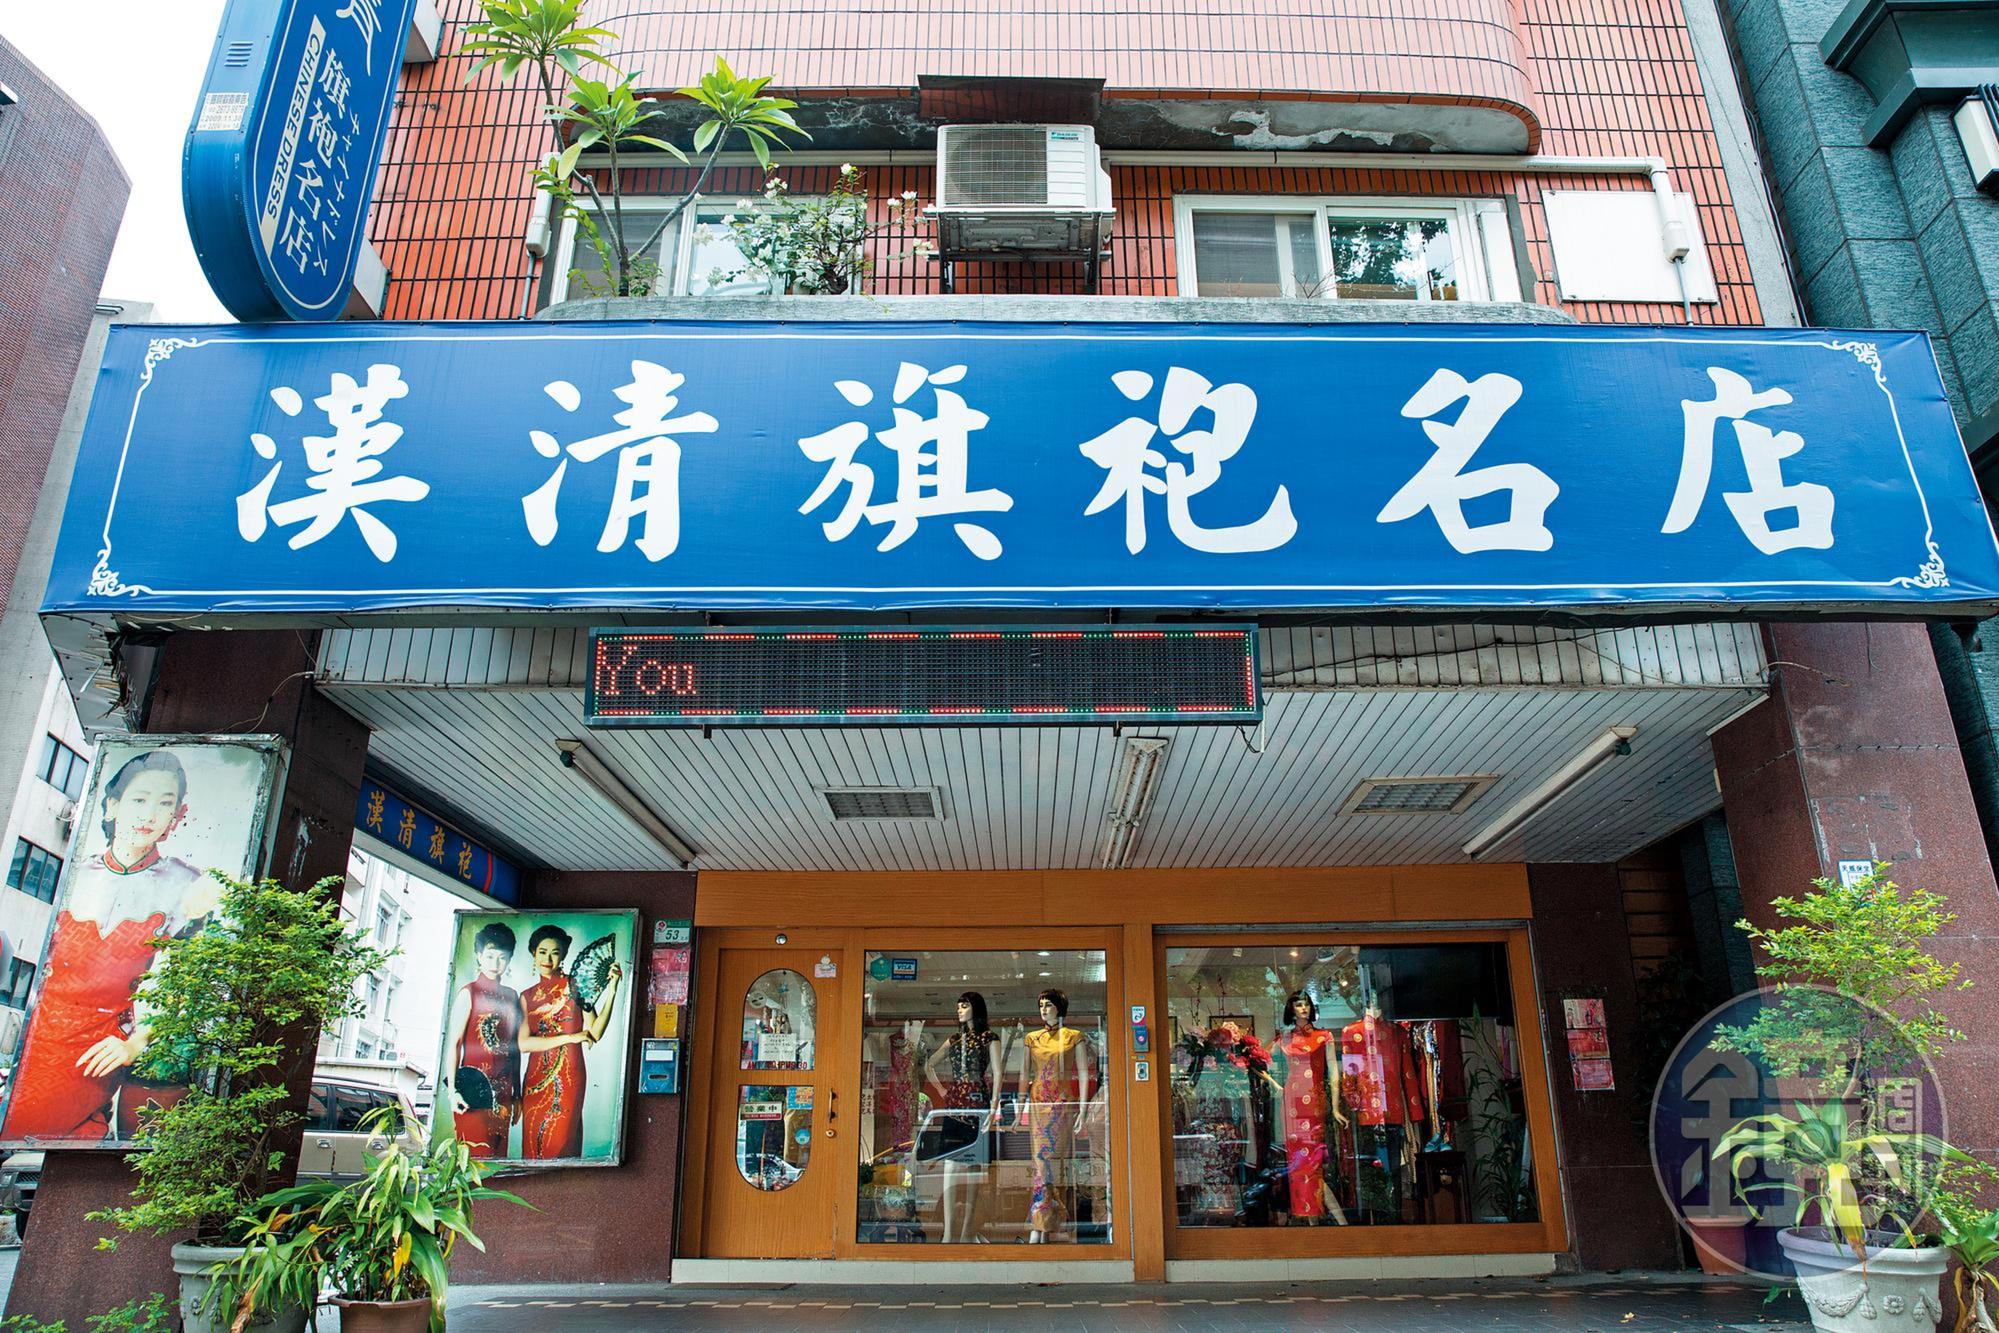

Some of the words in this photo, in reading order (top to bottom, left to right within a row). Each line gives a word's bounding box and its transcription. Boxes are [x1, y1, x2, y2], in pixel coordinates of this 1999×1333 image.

[287, 33, 321, 139] CHINESE
[268, 136, 293, 220] DRESS
[279, 48, 351, 275] 旗袍名店
[313, 107, 360, 277] チャイナドレス
[236, 359, 1835, 563] 漢清旗袍名店
[600, 645, 697, 695] You
[366, 789, 473, 880] 漢清旗袍
[665, 929, 680, 941] 53
